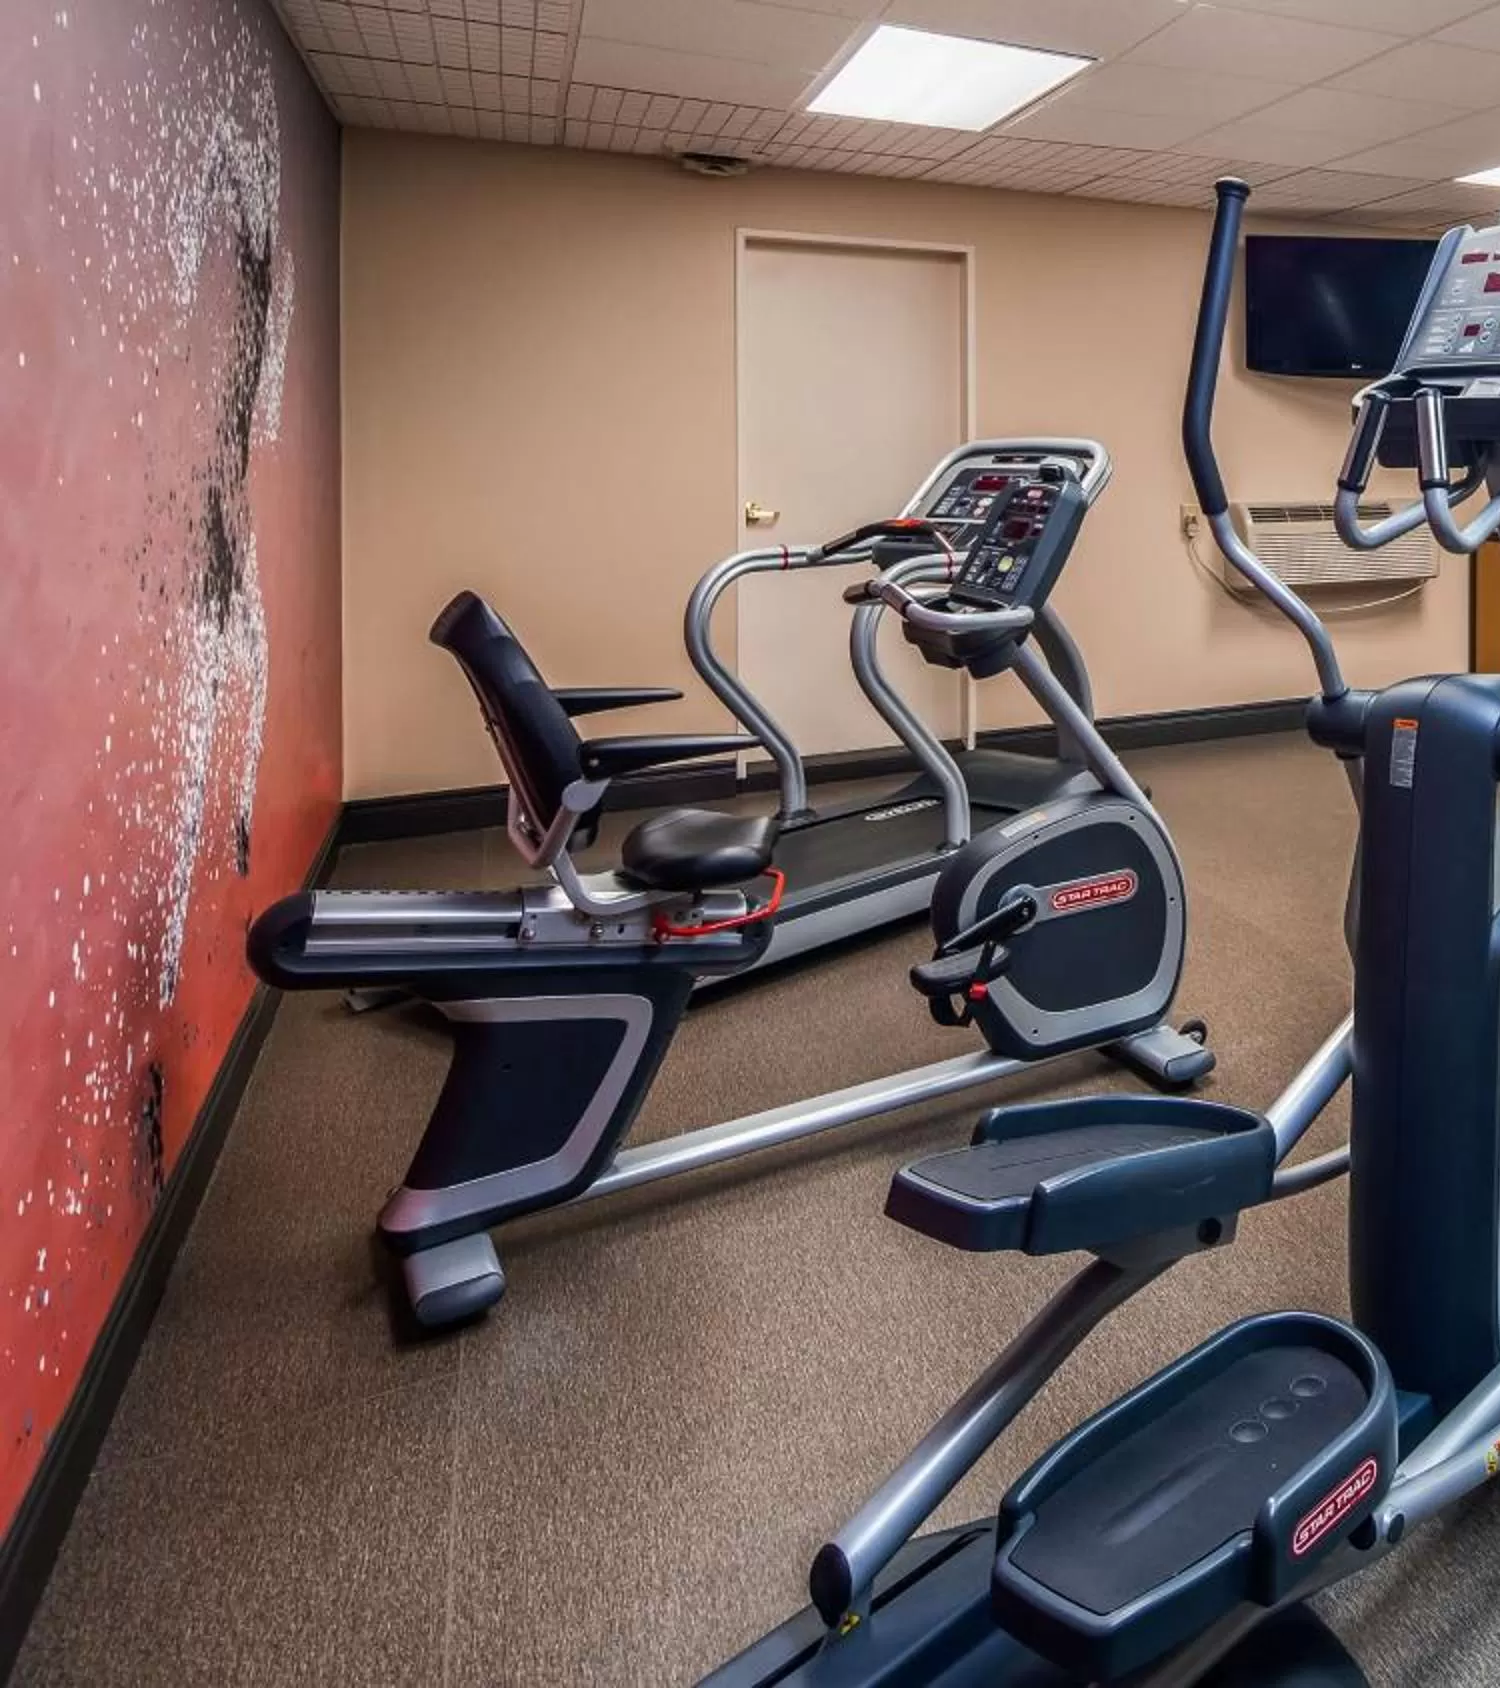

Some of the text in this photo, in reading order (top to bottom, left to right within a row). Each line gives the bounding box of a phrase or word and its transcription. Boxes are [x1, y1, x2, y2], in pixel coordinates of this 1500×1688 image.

[1056, 880, 1128, 904] STAR TRAC
[1298, 1468, 1372, 1541] STAR TRAC
